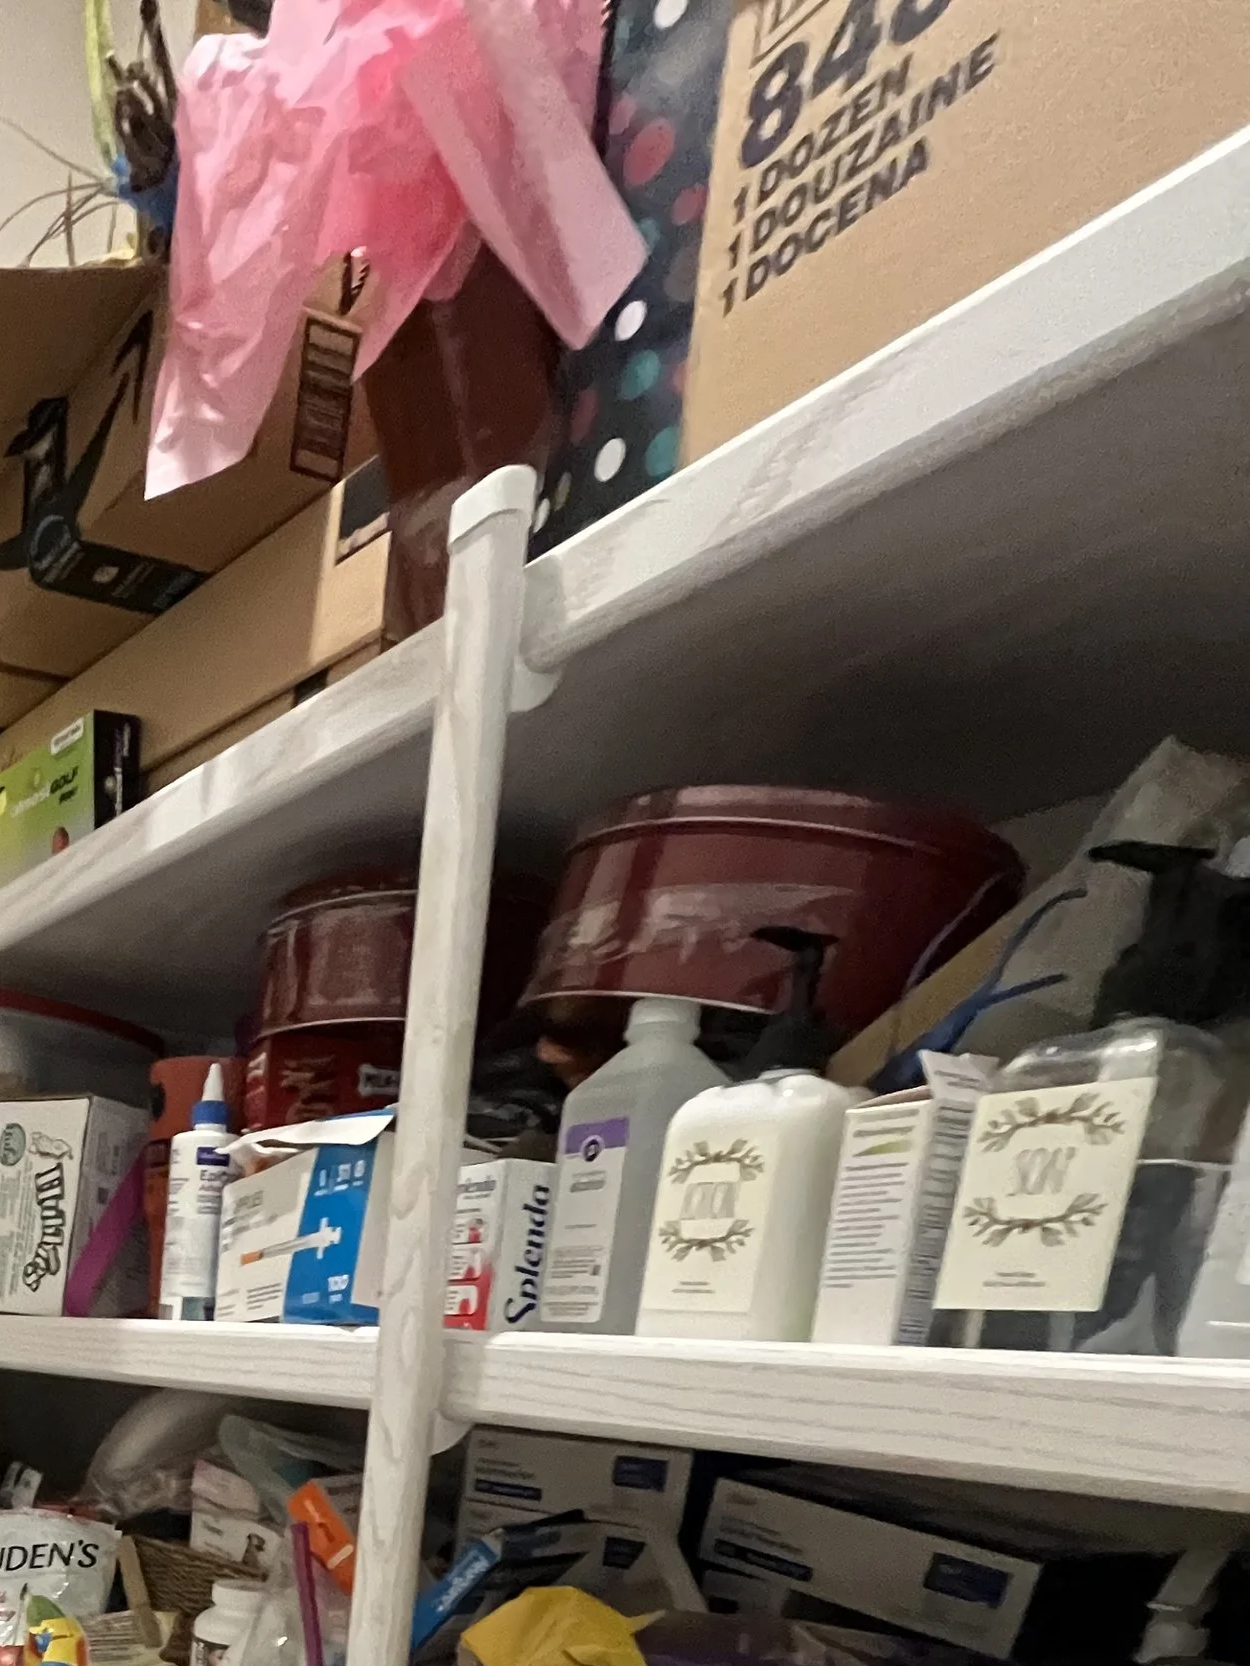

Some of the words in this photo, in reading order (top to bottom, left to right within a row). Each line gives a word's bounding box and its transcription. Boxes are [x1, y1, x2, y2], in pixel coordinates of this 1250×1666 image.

[721, 276, 739, 319] 1
[744, 135, 929, 302] DOCENA
[727, 230, 742, 272] 1
[750, 29, 1000, 252] DOUZAINE
[733, 183, 750, 227] 1
[756, 51, 915, 209] DOZEN
[503, 1184, 550, 1324] Splenda
